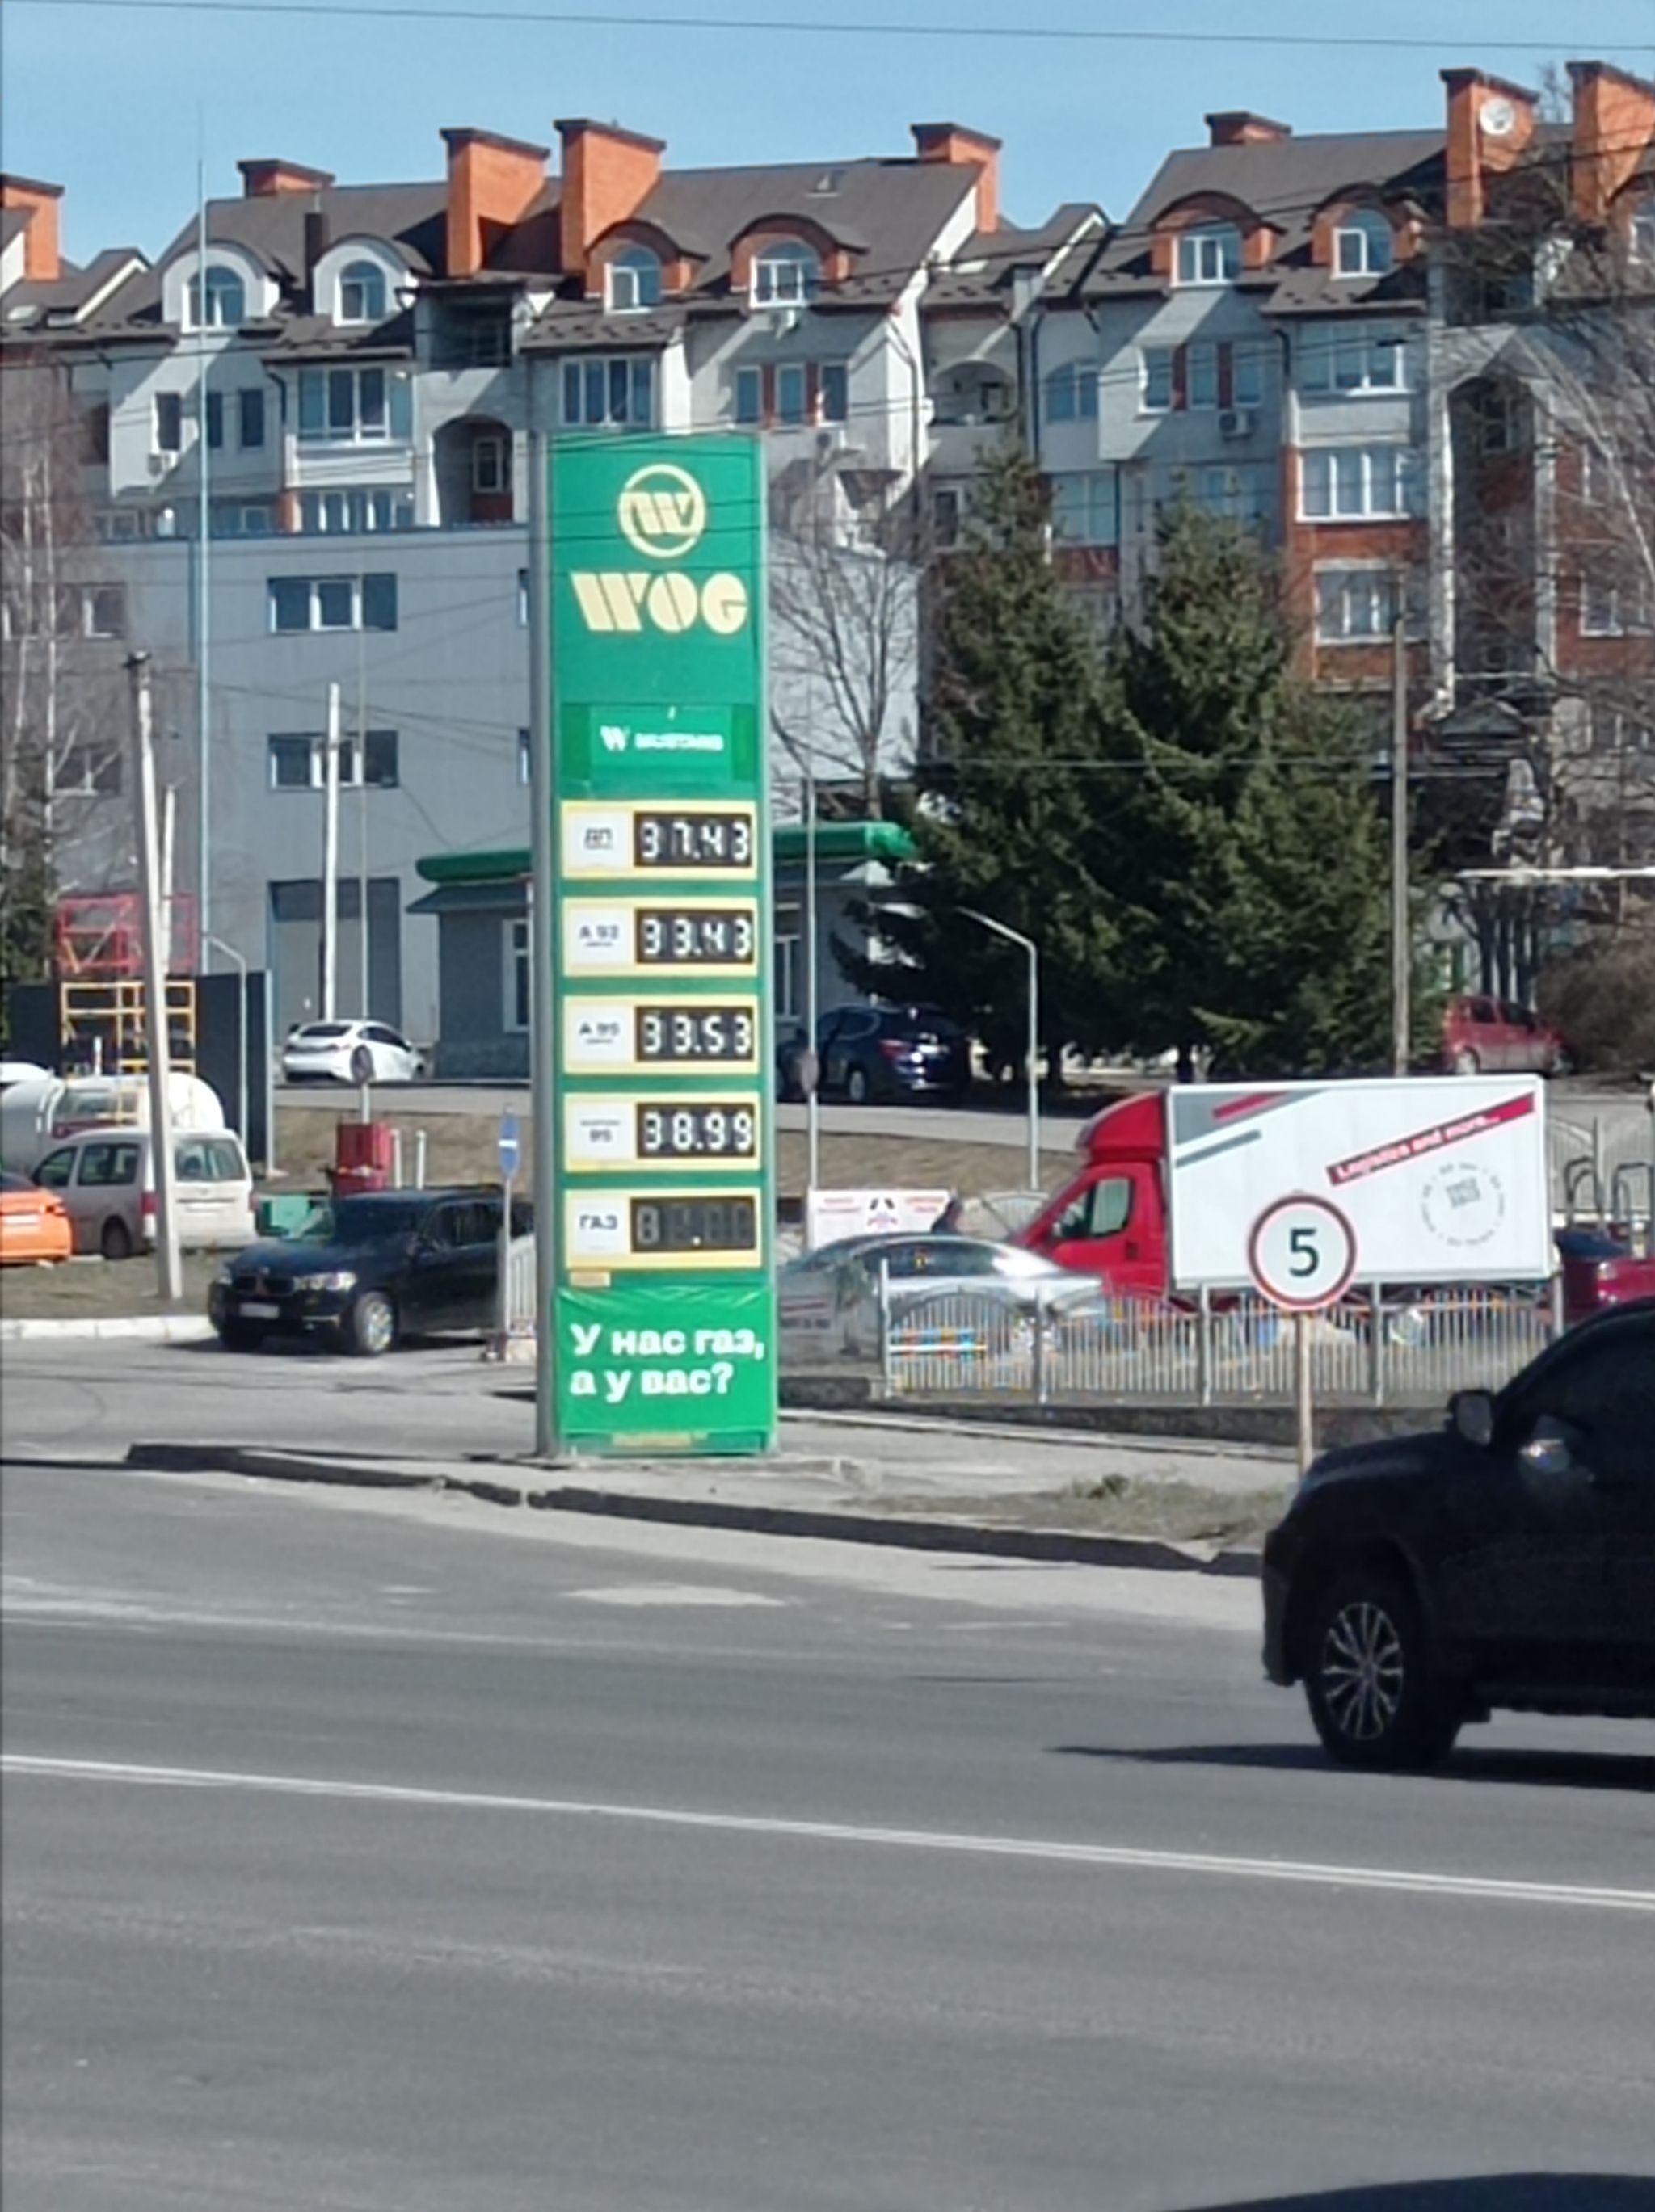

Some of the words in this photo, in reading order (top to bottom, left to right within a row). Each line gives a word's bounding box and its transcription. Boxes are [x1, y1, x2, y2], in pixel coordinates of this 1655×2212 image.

[571, 572, 748, 634] WOG
[642, 822, 750, 860] 37.43
[643, 918, 752, 959] 33.43
[644, 1015, 752, 1055] 33.53
[645, 1111, 752, 1151] 38.99
[579, 1215, 617, 1230] ГАЗ
[1288, 1227, 1320, 1278] 5
[570, 1323, 602, 1356] У
[612, 1329, 686, 1356] нас
[694, 1327, 765, 1360] газ,
[570, 1369, 596, 1394] а
[604, 1369, 633, 1403] у
[641, 1361, 734, 1394] вас?
